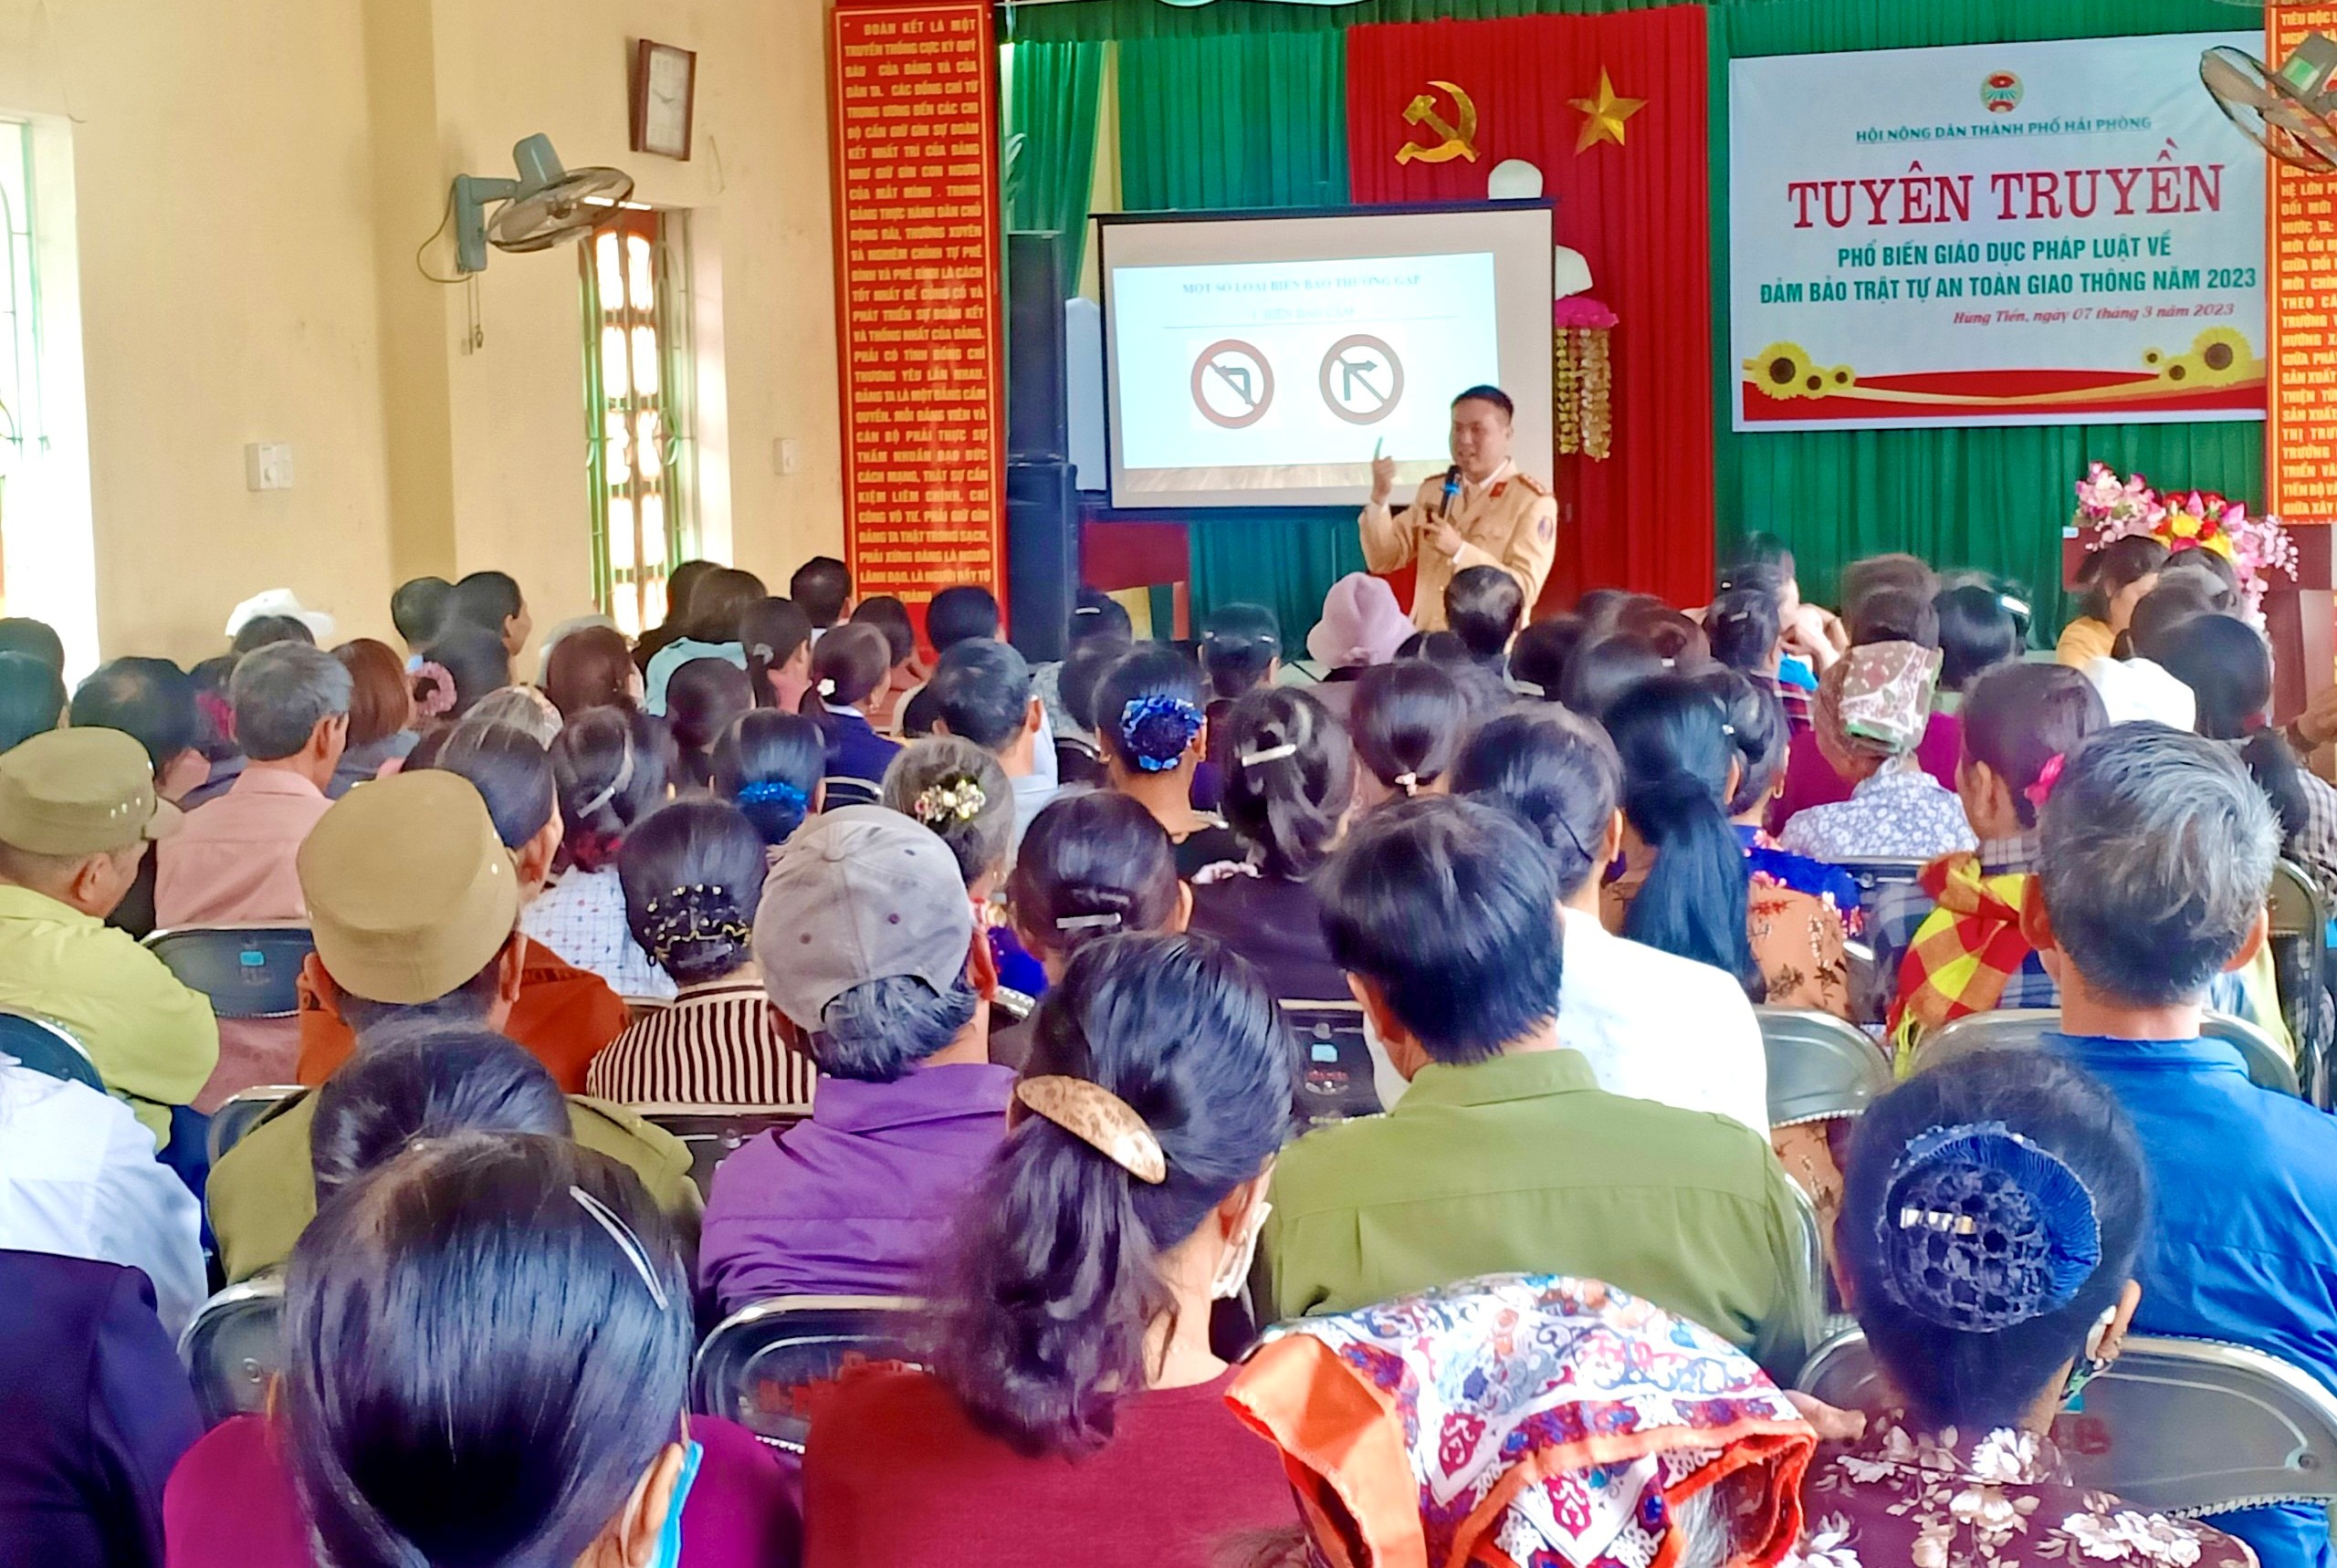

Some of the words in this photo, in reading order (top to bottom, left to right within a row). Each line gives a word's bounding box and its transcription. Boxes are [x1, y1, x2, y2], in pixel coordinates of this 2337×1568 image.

[902, 18, 924, 34] KẾT
[929, 18, 944, 33] LÀ
[1856, 127, 1883, 142] HỘI
[1887, 125, 1931, 141] NÔNG
[1934, 124, 1966, 138] DÂN
[1972, 120, 2024, 136] THÀNH
[2028, 115, 2060, 134] PHỐ
[2096, 115, 2152, 131] PHÒNG
[1787, 160, 1974, 228] TUYÊN
[1991, 138, 2226, 220] TRUYỀN
[1882, 239, 1927, 266] BIẾN
[1934, 239, 1980, 264] GIÁO
[1986, 242, 2025, 267] DỤC
[2033, 235, 2085, 260] PHÁP
[2093, 233, 2141, 262] LUẬT
[1760, 277, 1803, 304] ĐẢM
[1809, 275, 1848, 302] BẢO
[1853, 276, 1900, 305] TRẬT
[1905, 277, 1931, 303] TỰ
[1935, 277, 1963, 298] AN
[1969, 272, 2020, 296] TOÀN
[2028, 274, 2073, 295] GIAO
[2080, 267, 2145, 293] THÔNG
[2153, 266, 2200, 290] NĂM
[2207, 267, 2256, 288] 2023
[2072, 308, 2092, 320] 07
[2144, 306, 2153, 319] 3
[2194, 303, 2235, 317] 2023
[2281, 297, 2314, 309] THEO
